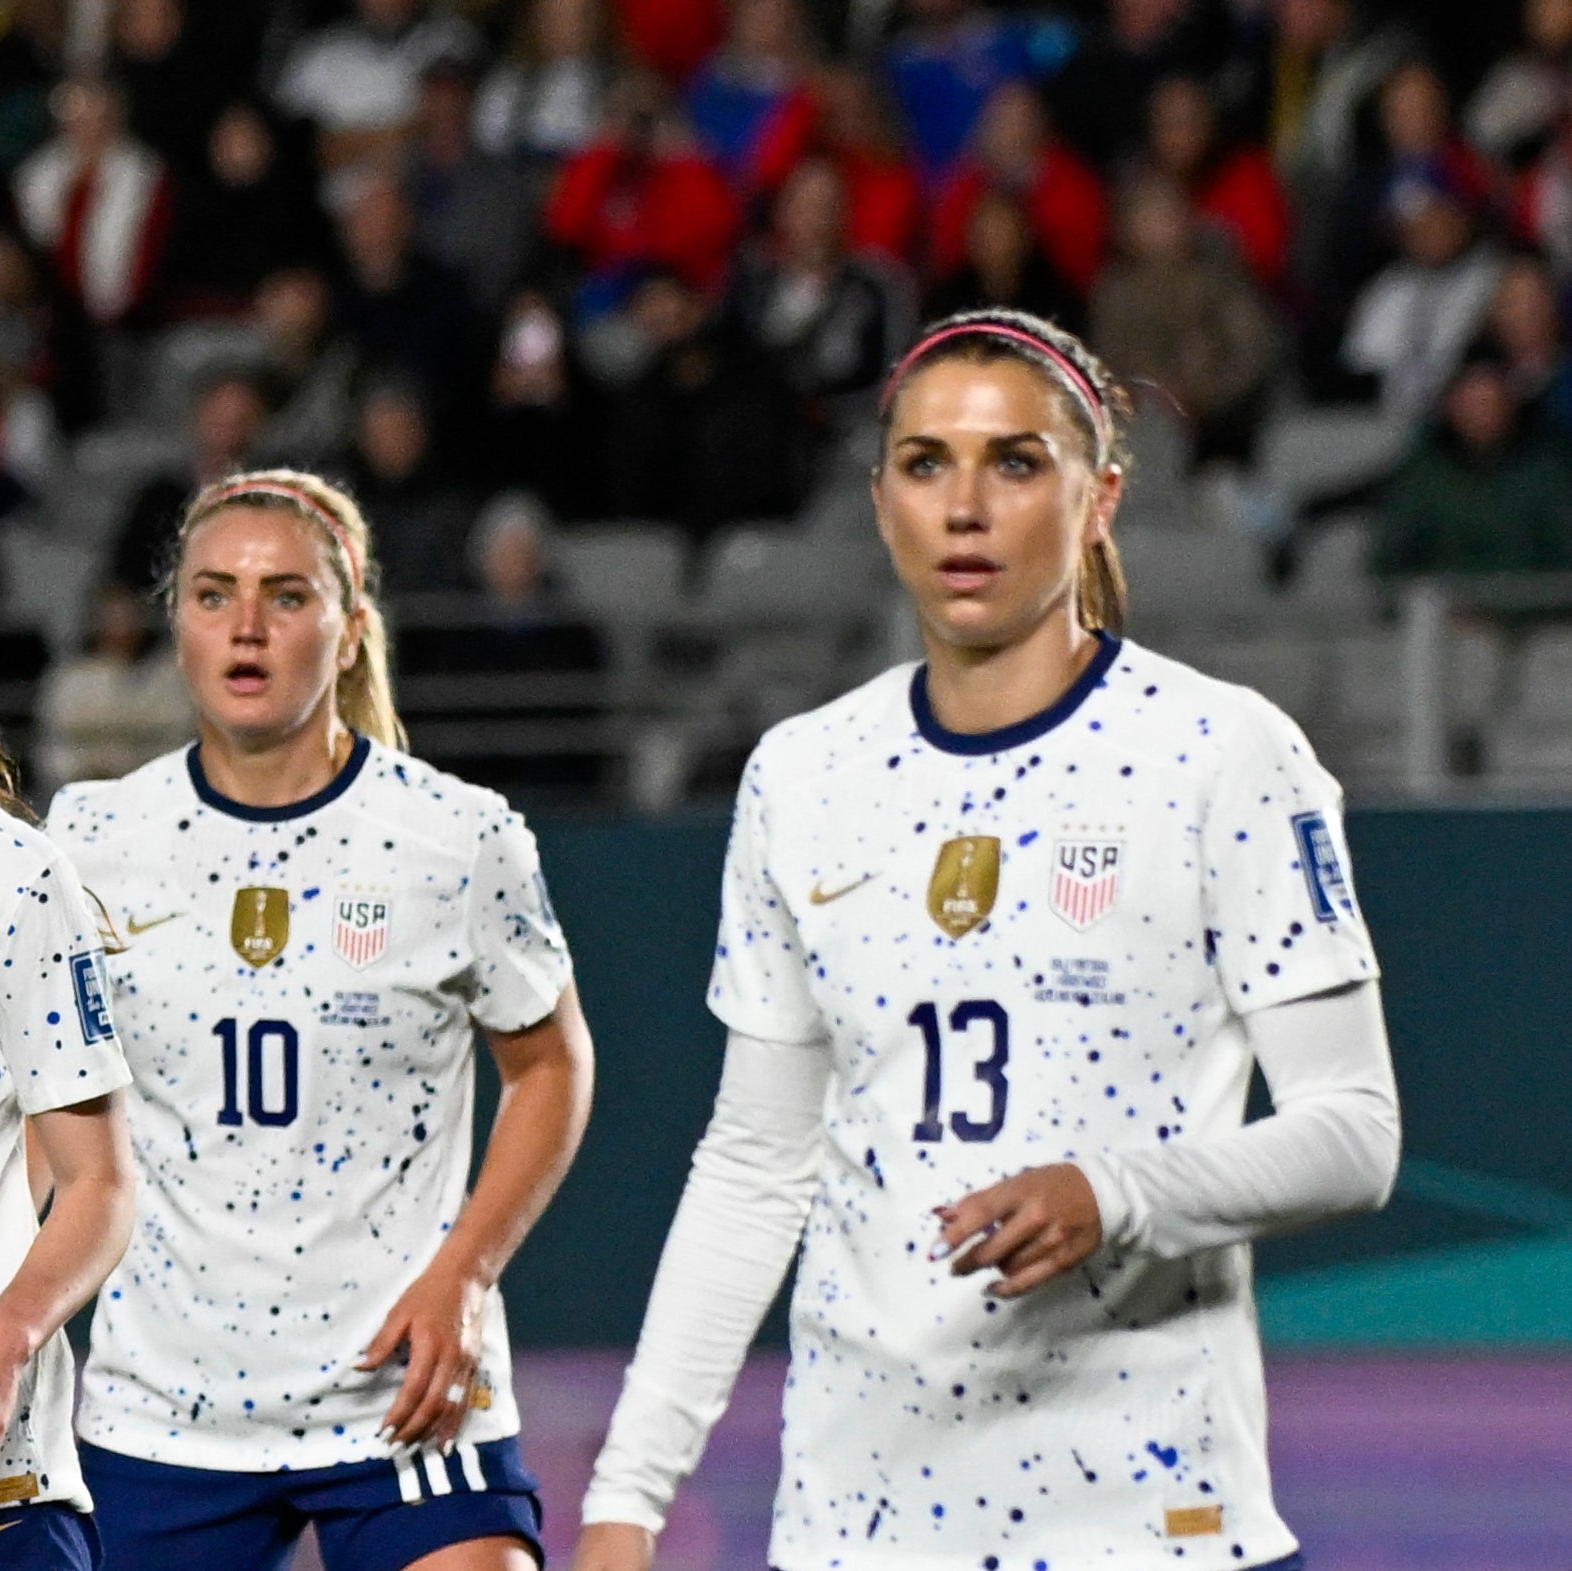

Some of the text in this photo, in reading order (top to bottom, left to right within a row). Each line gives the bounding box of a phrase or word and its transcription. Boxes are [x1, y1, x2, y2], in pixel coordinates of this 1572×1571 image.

[1060, 846, 1118, 878] USA
[339, 902, 386, 928] USA
[212, 1018, 298, 1128] 10
[908, 999, 1008, 1142] 13
